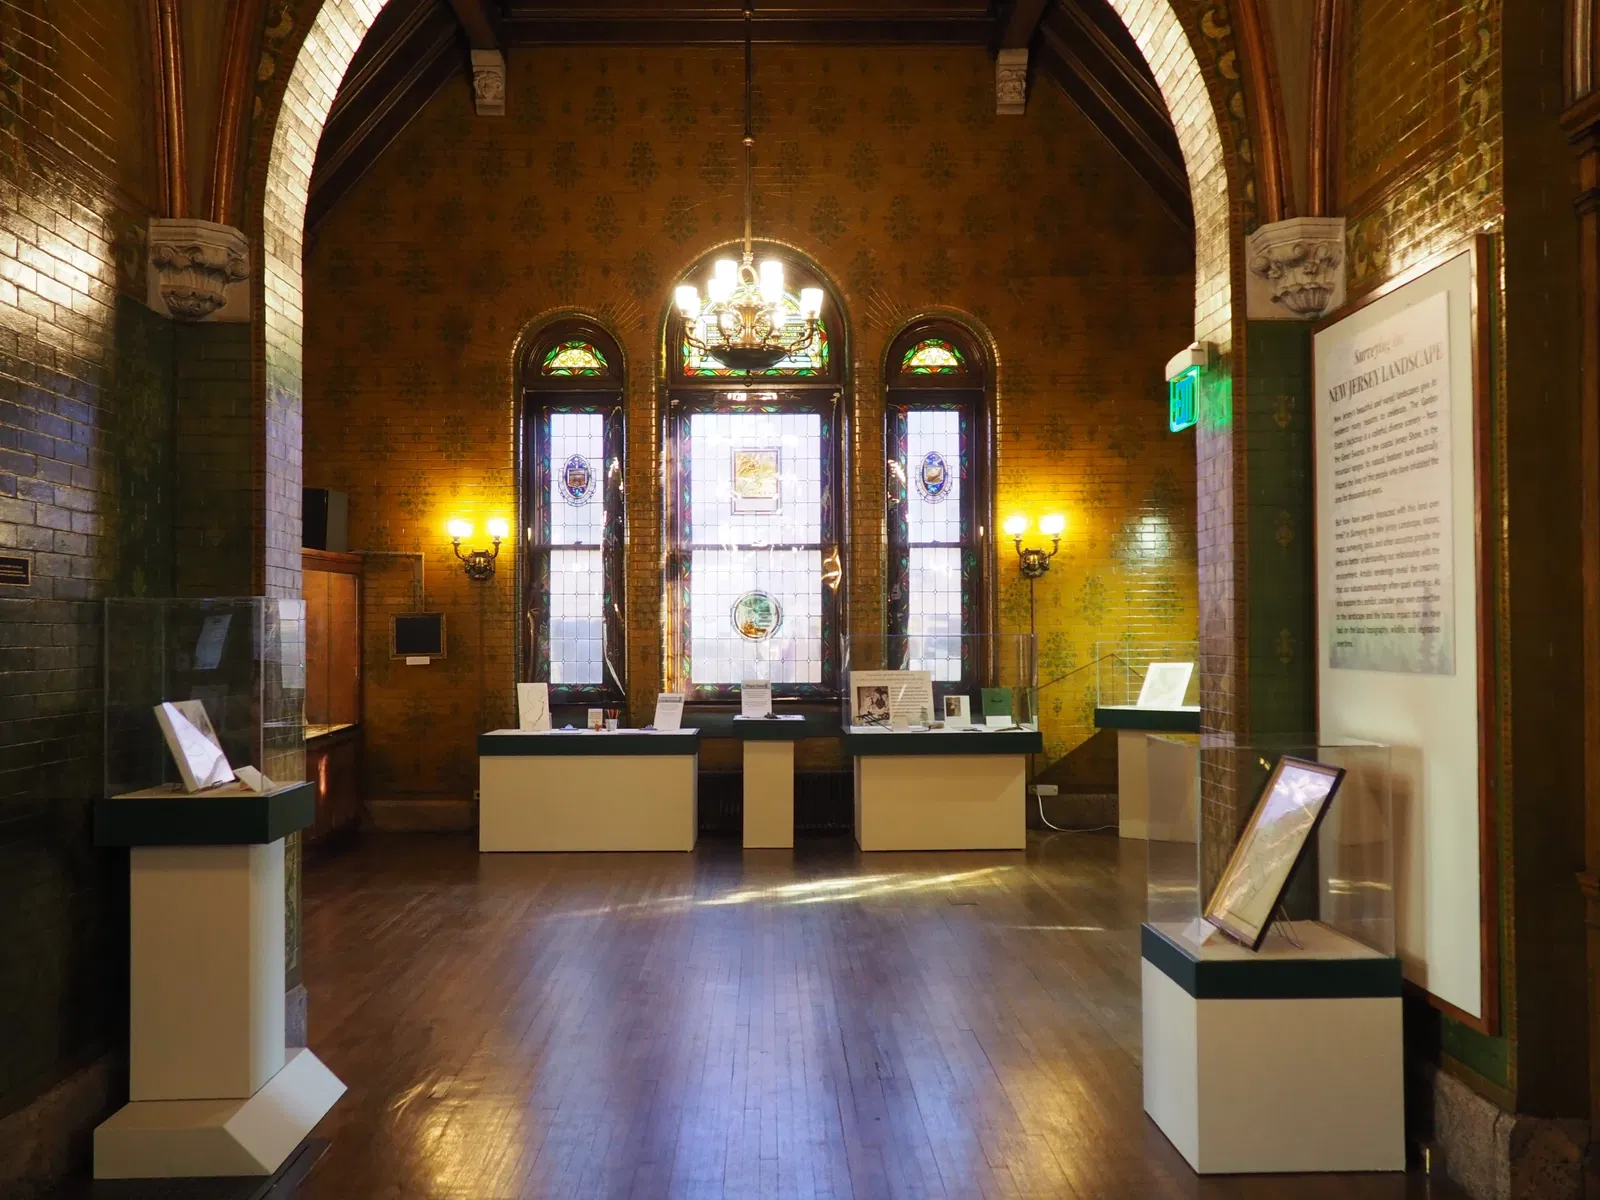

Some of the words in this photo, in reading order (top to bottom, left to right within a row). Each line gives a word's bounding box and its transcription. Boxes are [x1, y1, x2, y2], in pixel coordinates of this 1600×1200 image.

[1328, 381, 1348, 403] NEW
[1347, 367, 1381, 401] JERSEY
[1380, 341, 1444, 383] LANDSCAPE
[1353, 341, 1391, 365] Surveying
